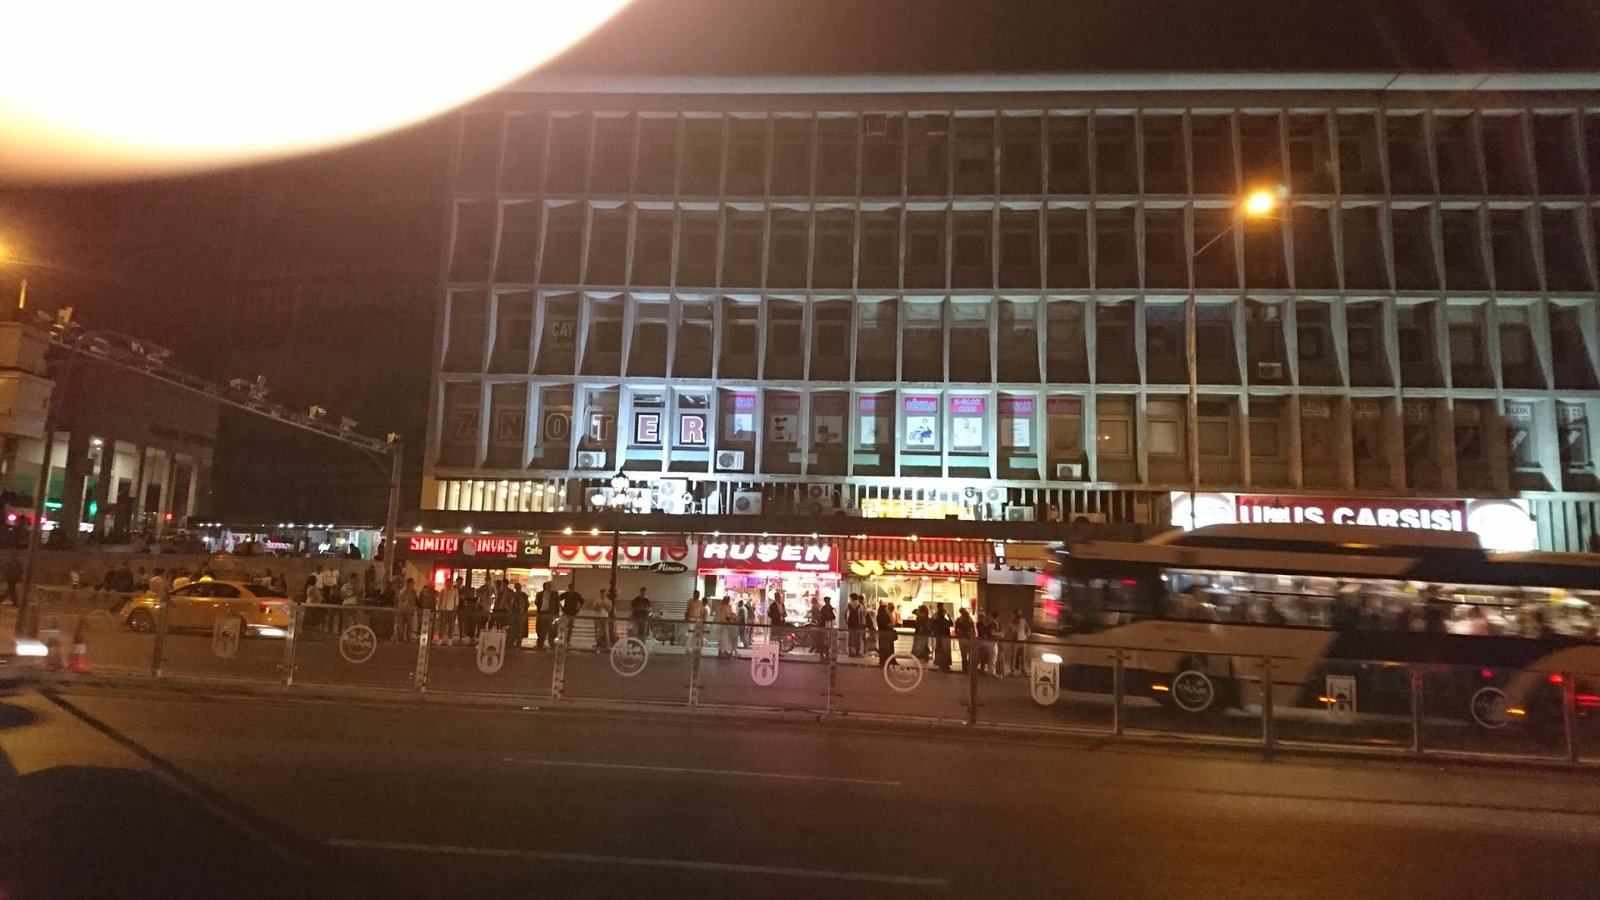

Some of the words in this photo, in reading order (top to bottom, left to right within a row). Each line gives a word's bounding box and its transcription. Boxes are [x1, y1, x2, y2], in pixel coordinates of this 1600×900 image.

[499, 412, 705, 443] NOTER
[463, 539, 518, 553] NYASI
[525, 547, 543, 555] Cafe
[703, 543, 831, 562] RUŞEN
